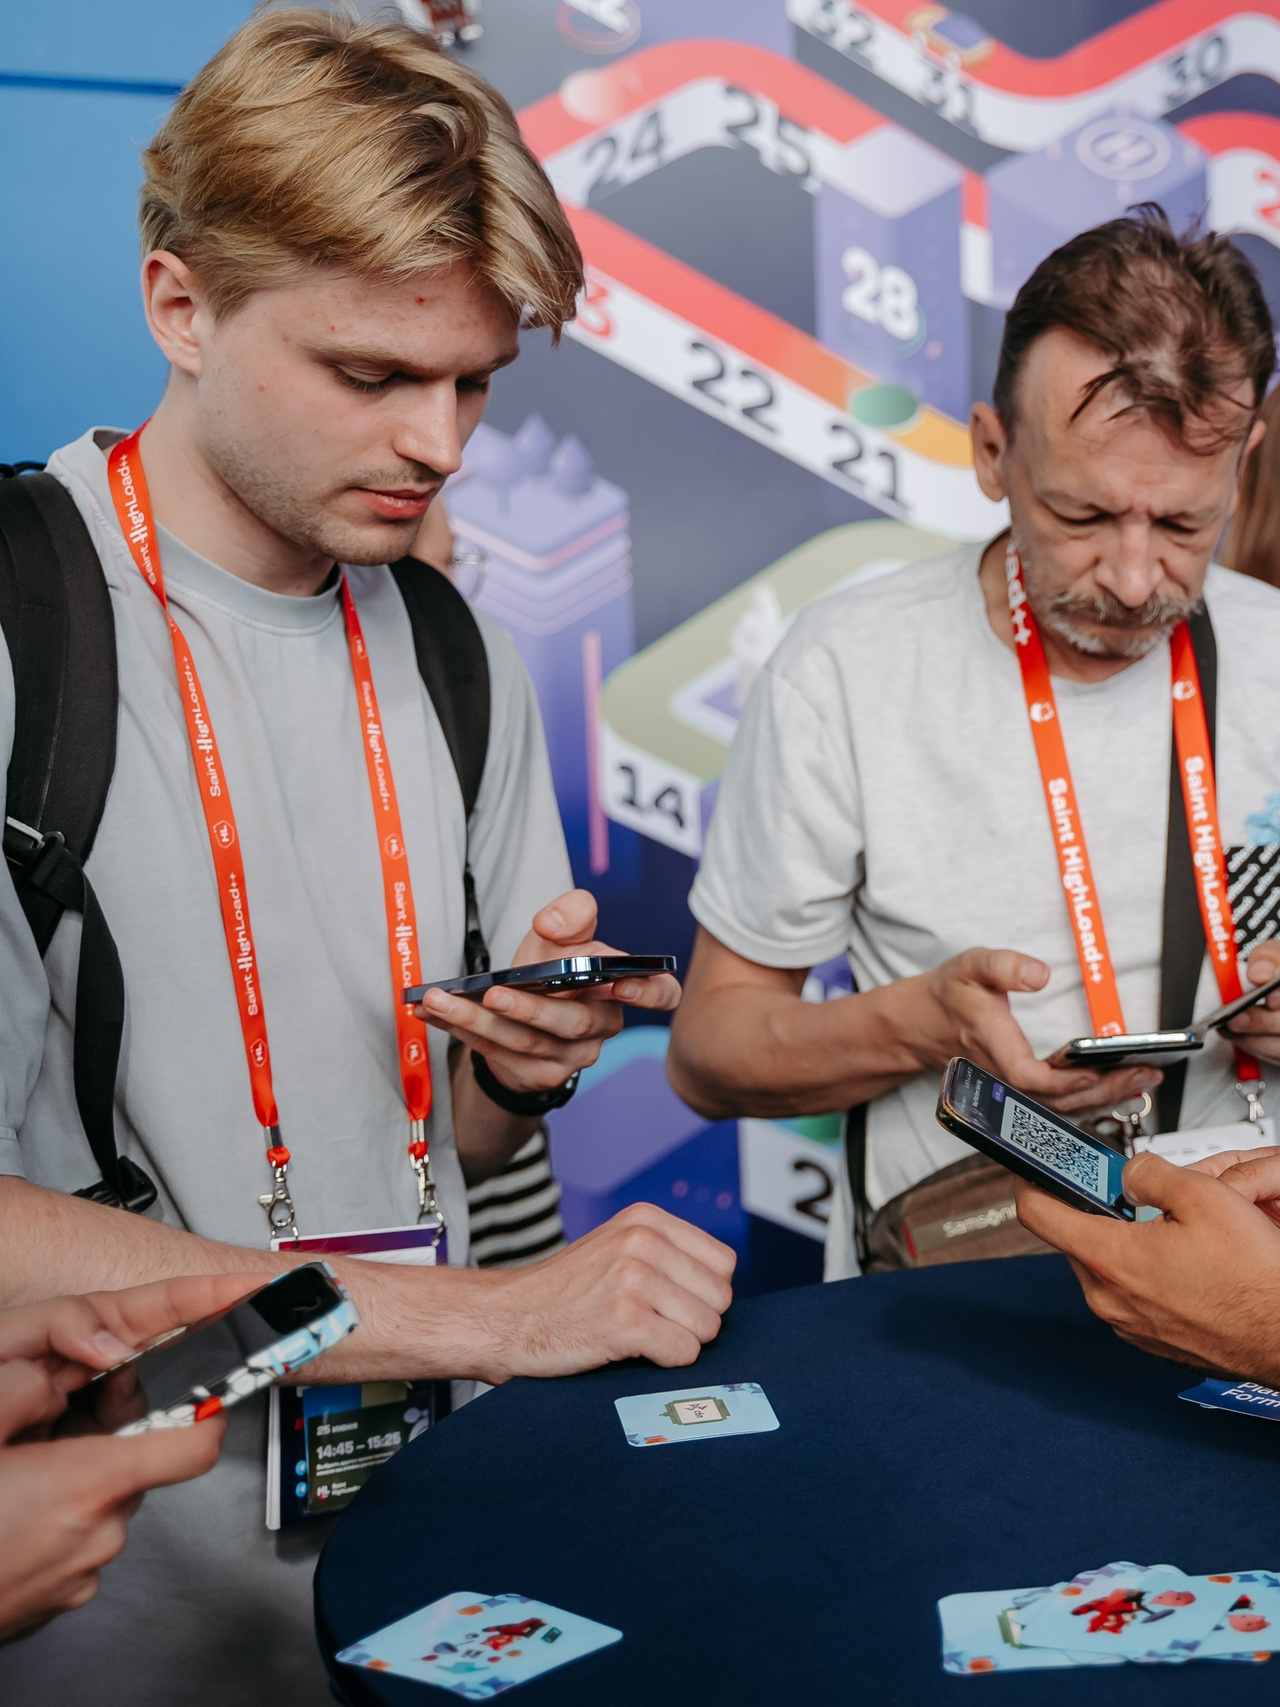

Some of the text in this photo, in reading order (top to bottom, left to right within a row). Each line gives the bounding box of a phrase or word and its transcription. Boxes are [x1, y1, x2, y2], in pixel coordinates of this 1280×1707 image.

[584, 112, 665, 192] 24
[722, 80, 812, 178] 25
[690, 341, 778, 434] 22
[829, 423, 909, 511] 21
[140, 543, 157, 585] Saint
[183, 656, 222, 798] Saint HighLoad++
[618, 763, 687, 829] 14
[393, 881, 408, 921] Saint
[1048, 777, 1105, 984] Saint HighLoad++
[1184, 755, 1230, 963] Saint HighLoad++
[228, 872, 259, 1017] Saint HighLoad++
[316, 1440, 354, 1460] 14:45
